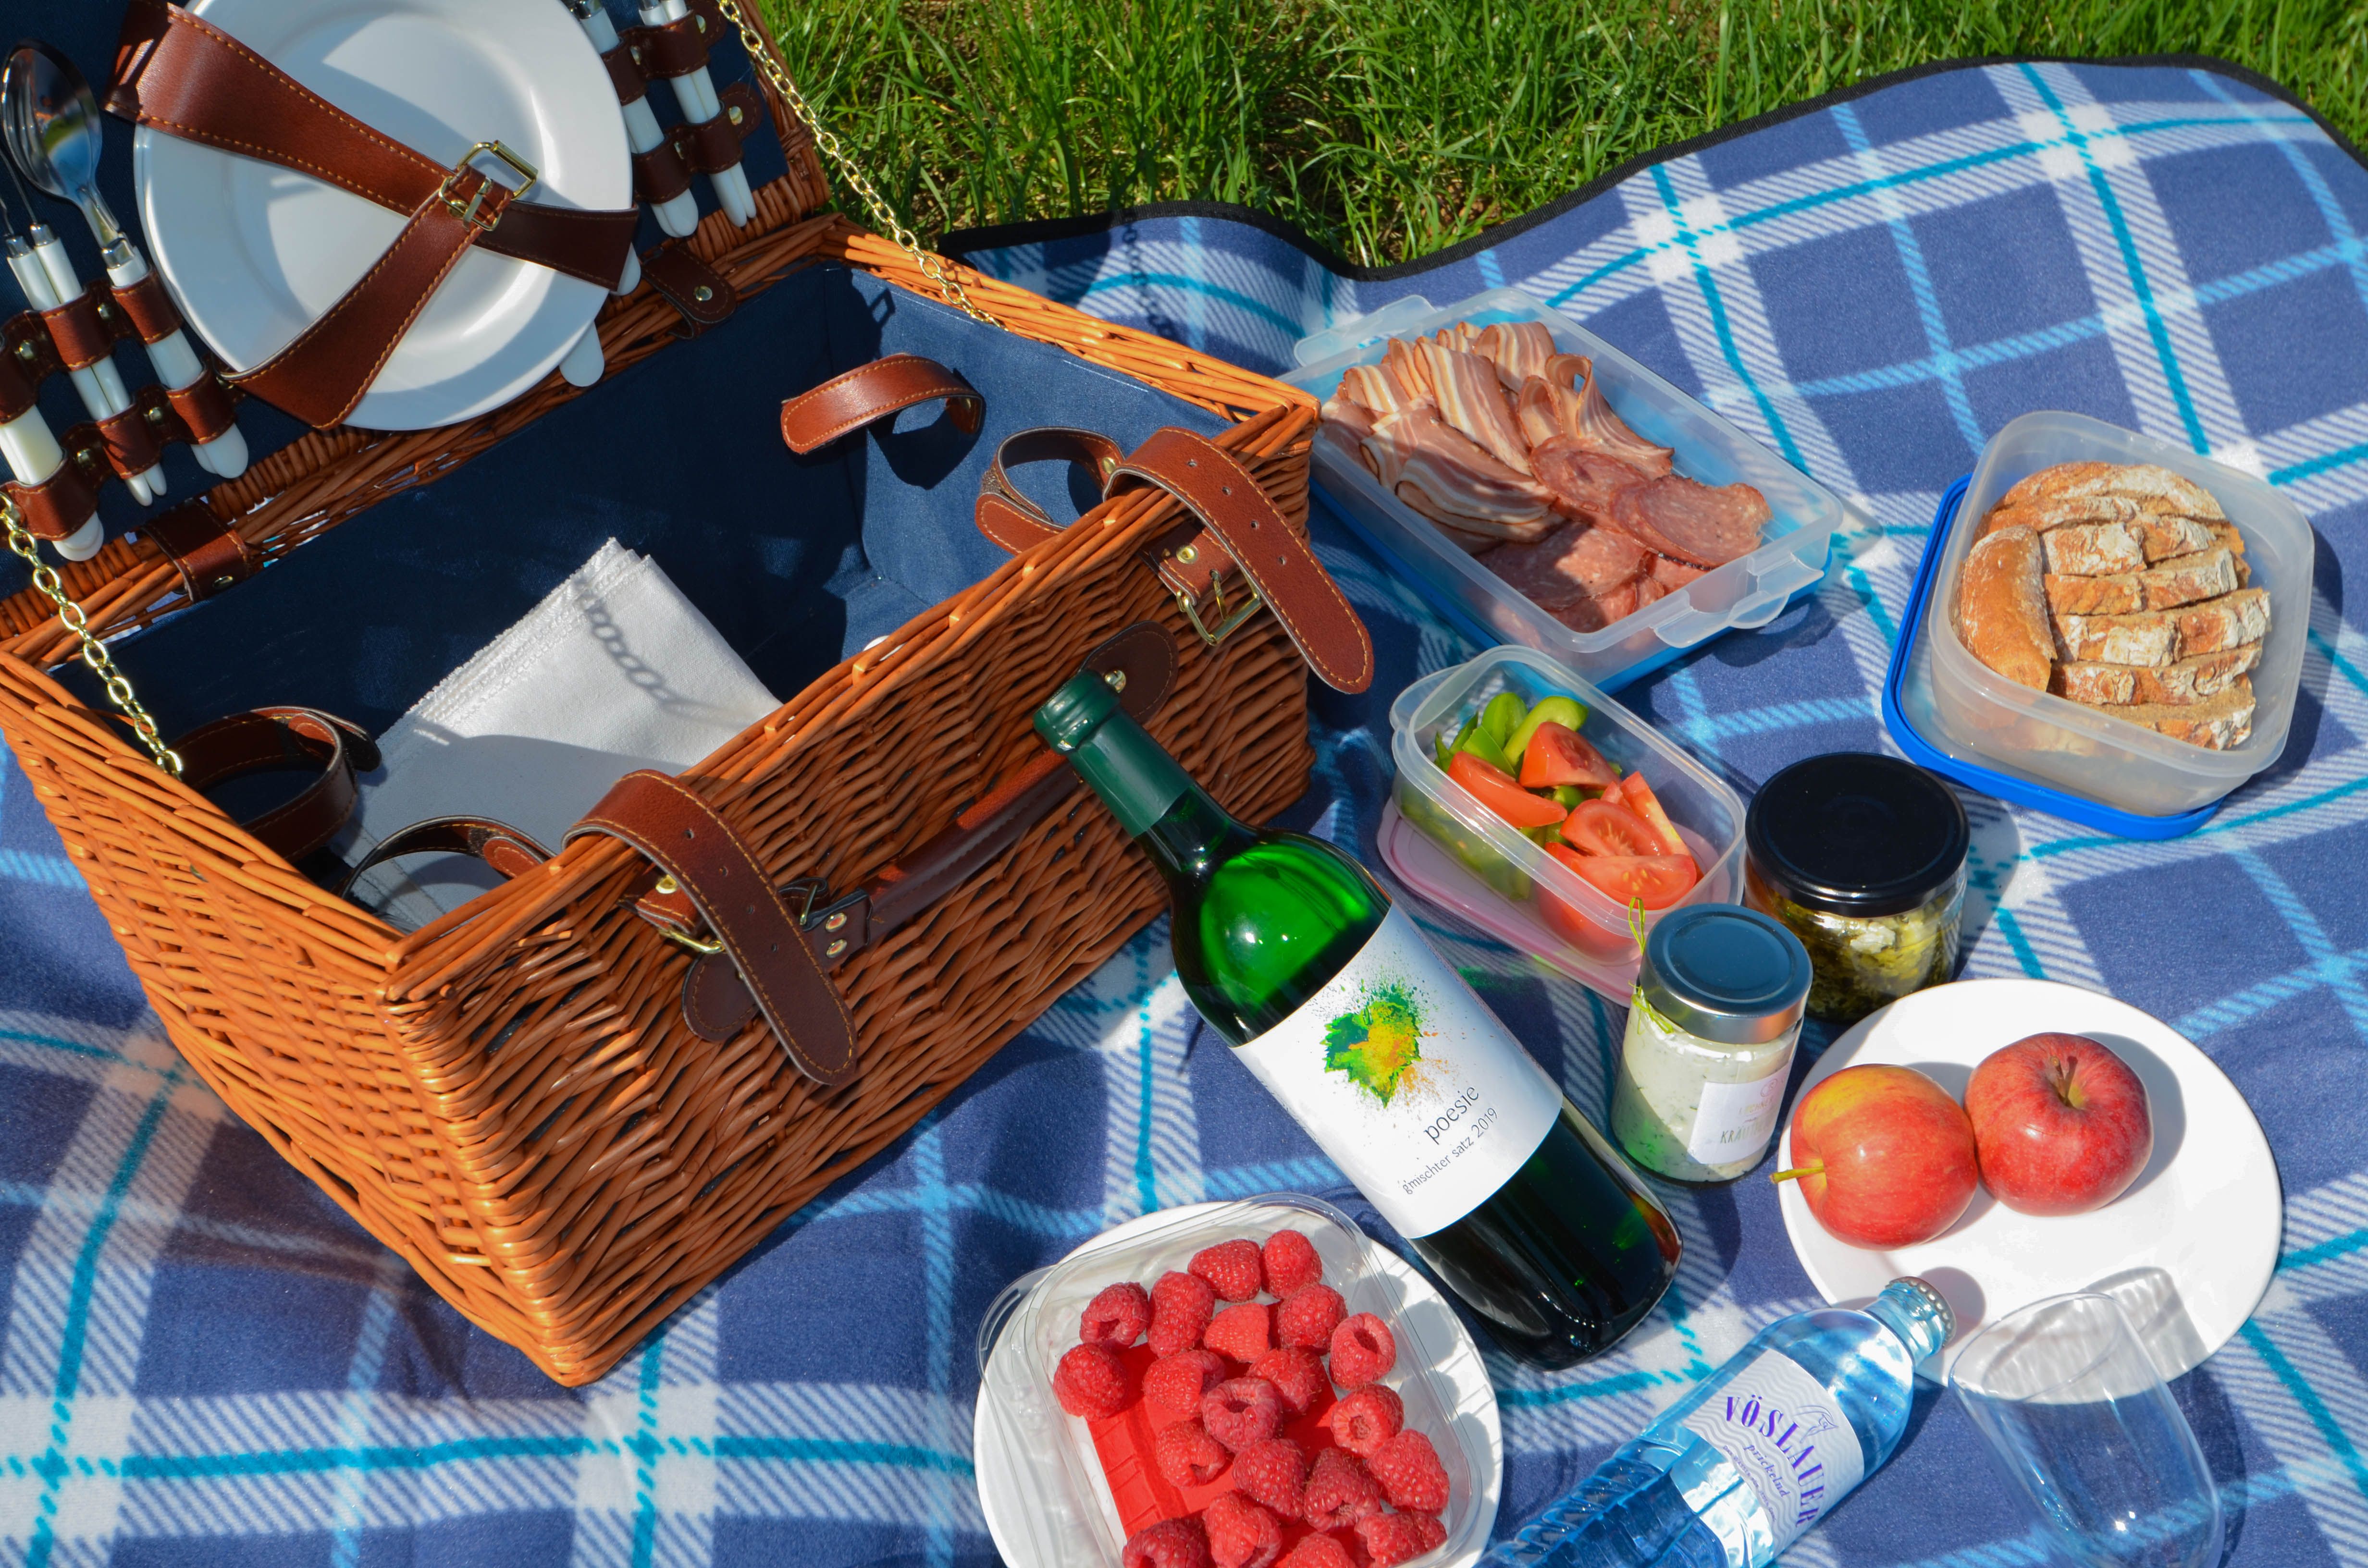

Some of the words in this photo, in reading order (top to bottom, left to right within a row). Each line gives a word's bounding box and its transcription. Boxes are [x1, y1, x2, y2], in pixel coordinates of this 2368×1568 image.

[1423, 1086, 1479, 1145] poesie
[1452, 1137, 1474, 1157] satz
[1471, 1107, 1498, 1138] 2019
[1726, 1394, 1825, 1528] VÖSLAUER
[1742, 1445, 1790, 1497] prickelnd
